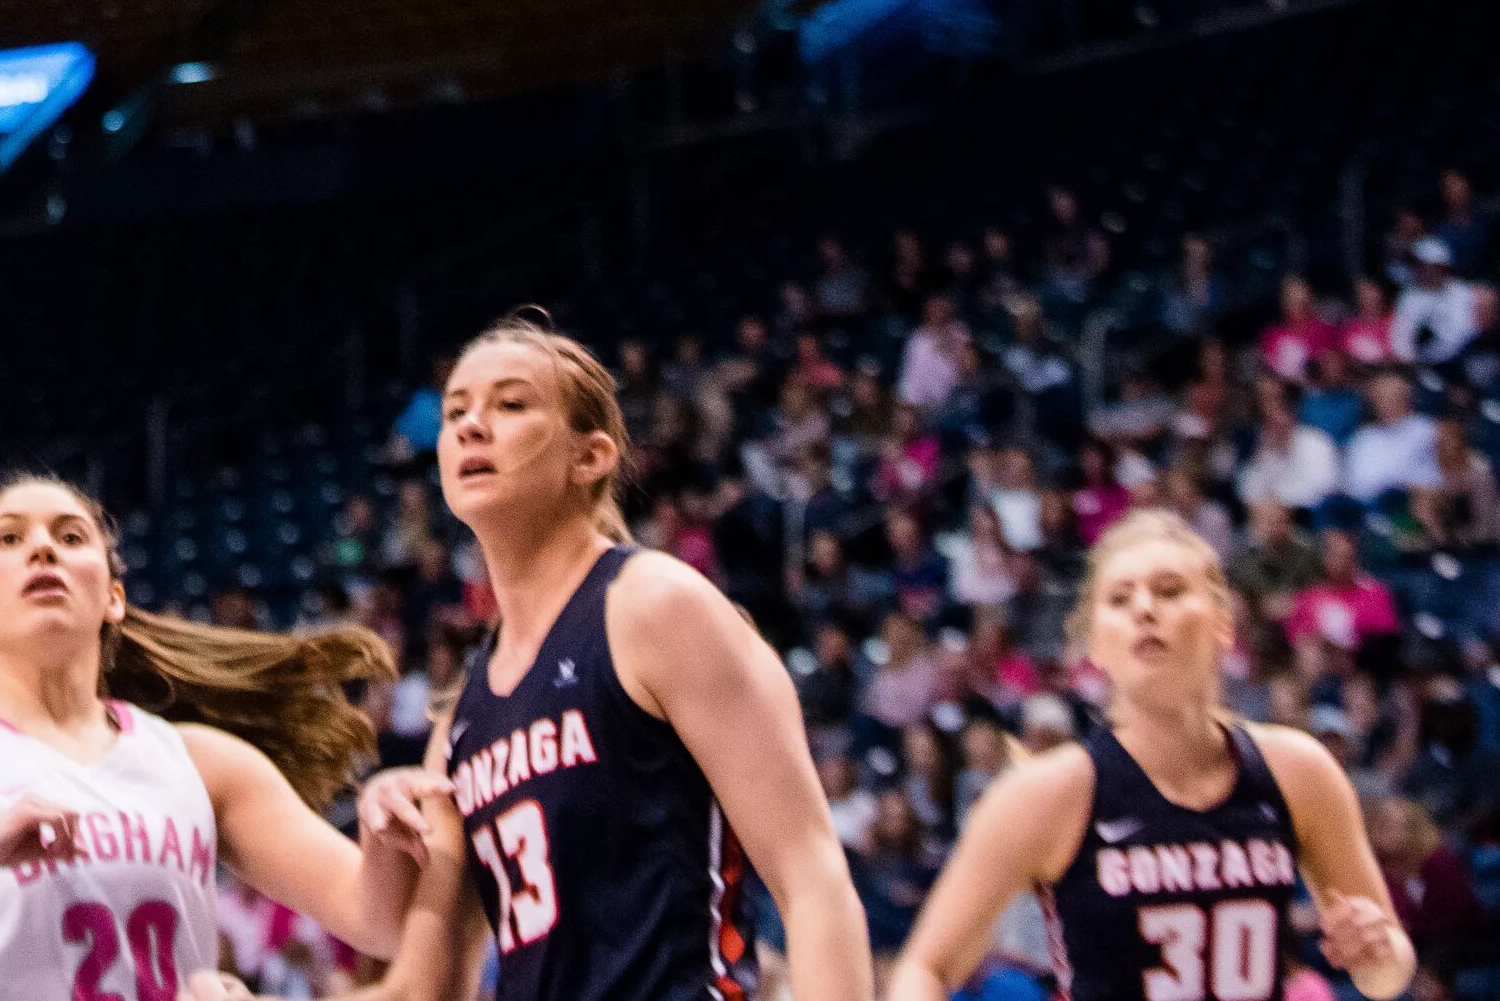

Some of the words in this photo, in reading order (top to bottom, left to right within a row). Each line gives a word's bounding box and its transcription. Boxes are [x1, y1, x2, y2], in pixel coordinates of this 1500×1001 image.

[471, 798, 560, 955] 13
[1097, 836, 1296, 897] GONZAGA
[61, 900, 179, 1001] 20
[1136, 897, 1277, 1001] 30
